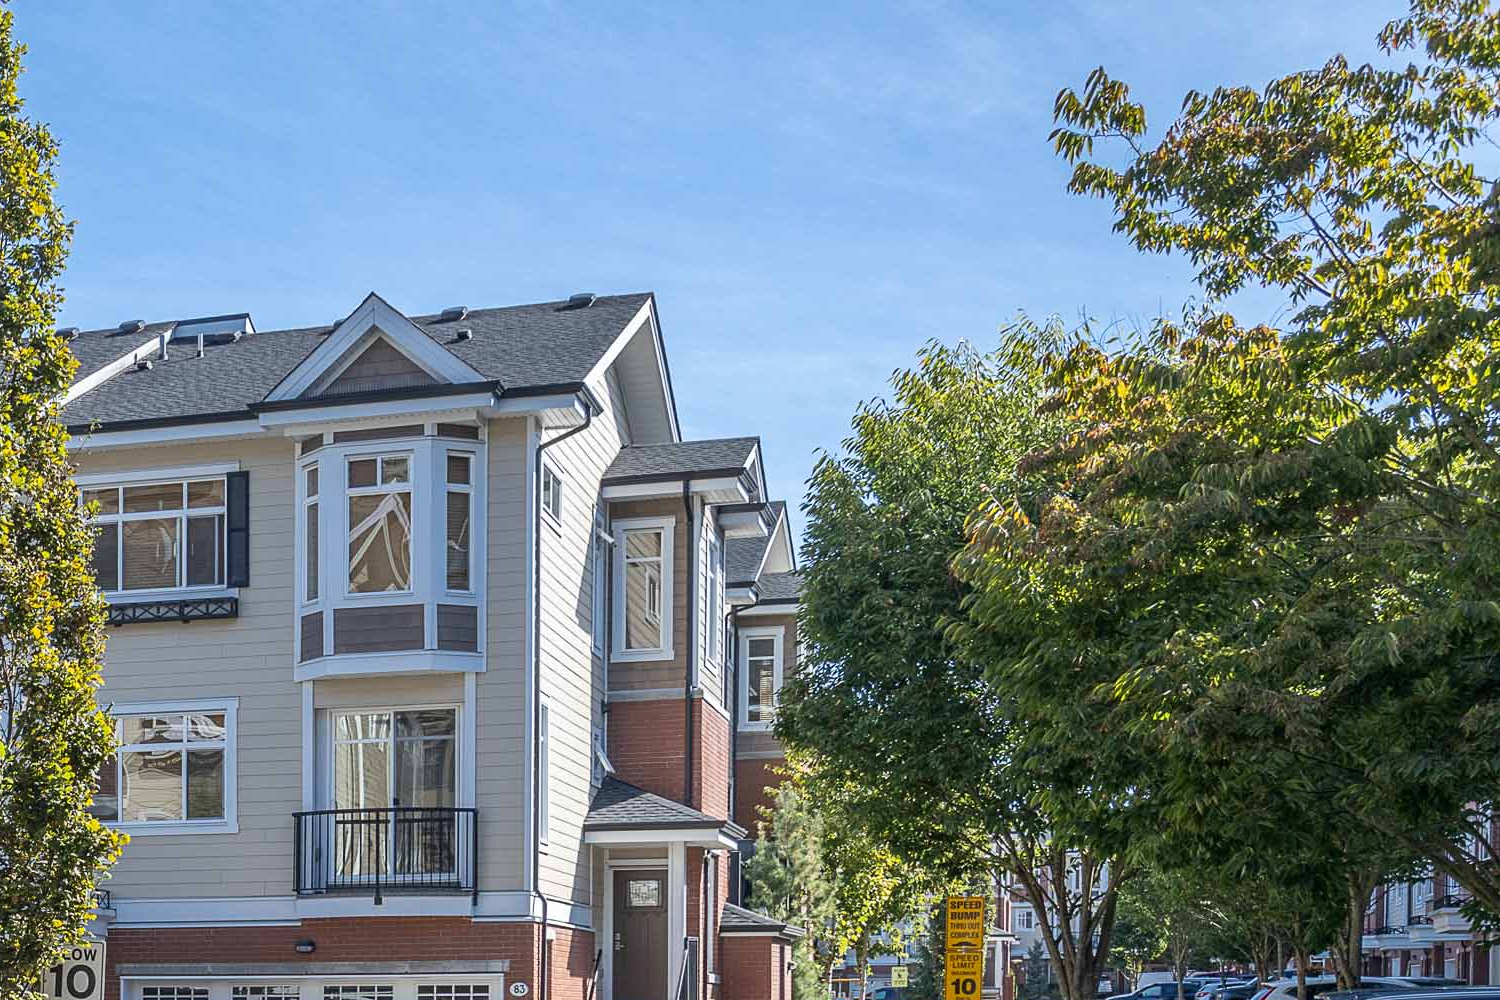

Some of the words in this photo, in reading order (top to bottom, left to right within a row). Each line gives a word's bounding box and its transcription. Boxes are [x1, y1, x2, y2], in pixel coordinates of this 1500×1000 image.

[949, 900, 982, 910] SPEED
[949, 911, 981, 921] BUMP
[949, 954, 980, 962] SPEED
[952, 961, 976, 969] LIMIT
[49, 963, 96, 1000] 10
[951, 978, 977, 995] 10
[513, 984, 526, 994] 83
